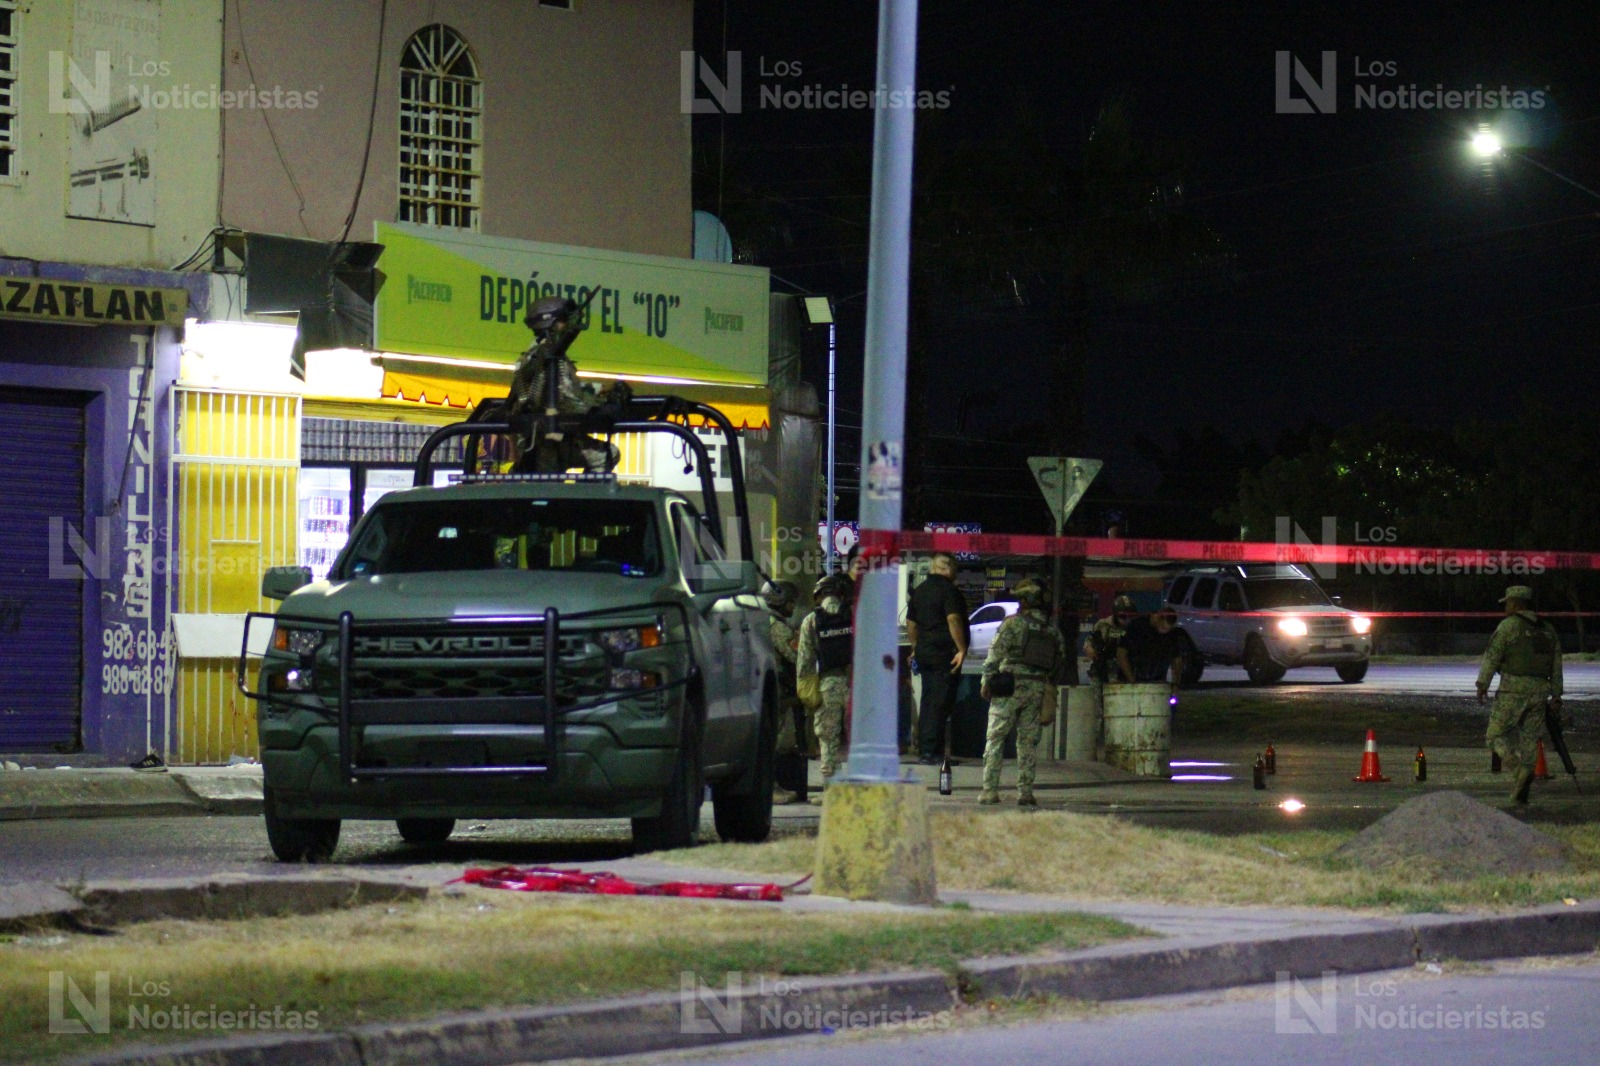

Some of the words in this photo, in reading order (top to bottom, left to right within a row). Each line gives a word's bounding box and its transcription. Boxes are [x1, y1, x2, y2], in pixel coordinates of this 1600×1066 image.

[0, 280, 166, 321] ZATLAN
[601, 288, 624, 334] EL
[1202, 543, 1244, 559] PELIGRO
